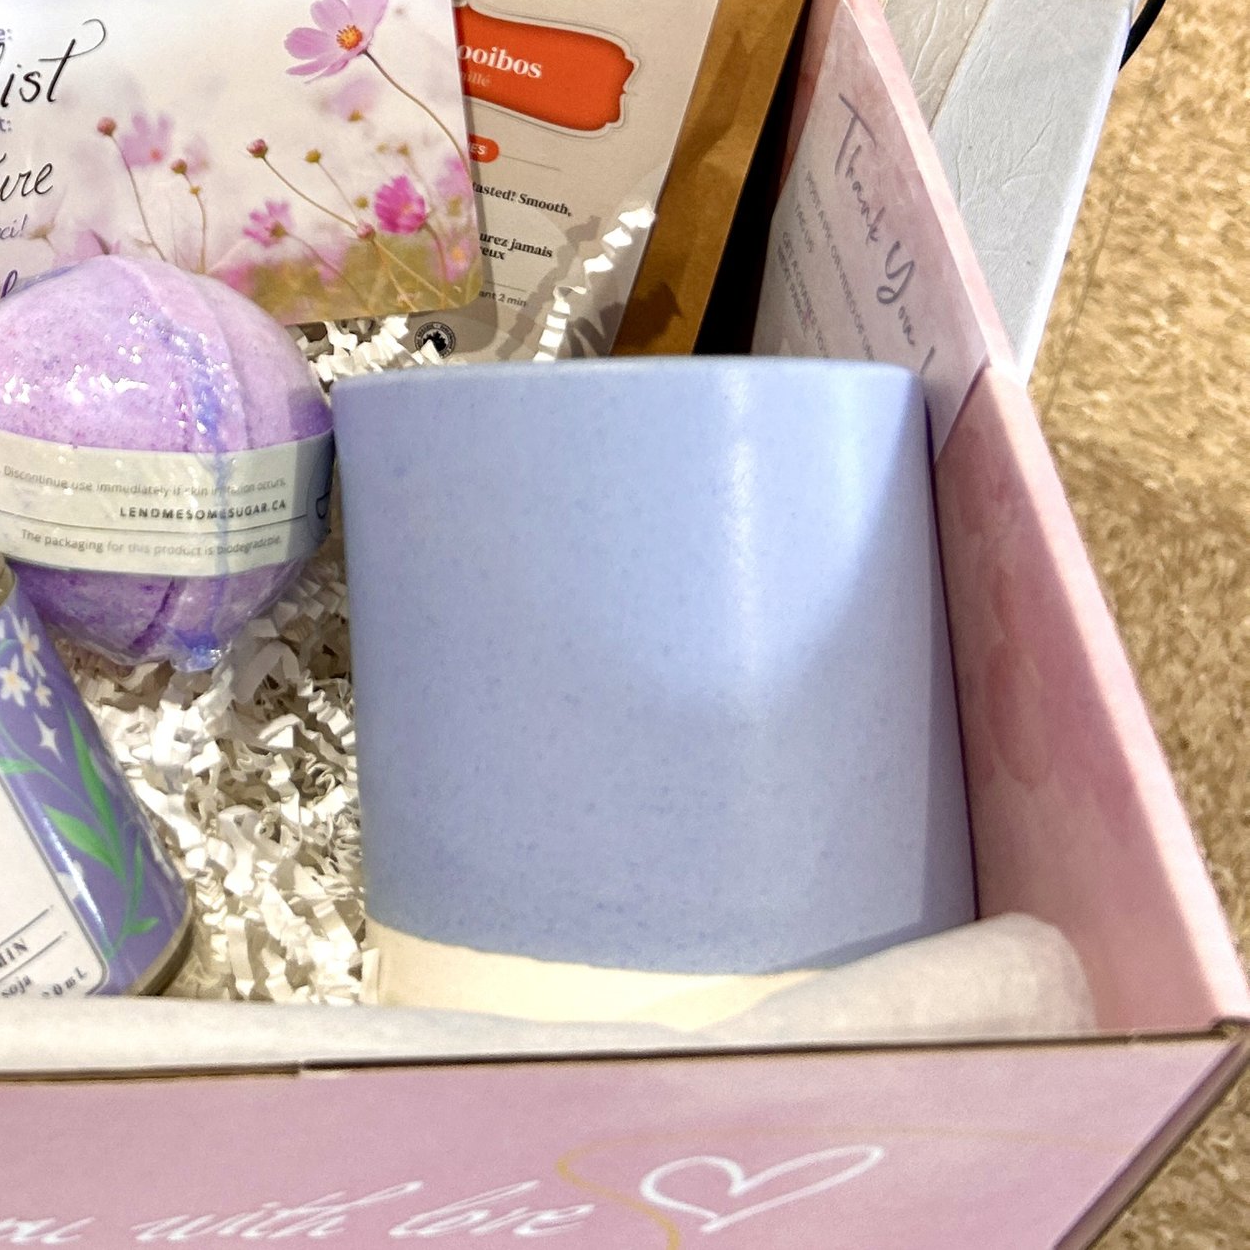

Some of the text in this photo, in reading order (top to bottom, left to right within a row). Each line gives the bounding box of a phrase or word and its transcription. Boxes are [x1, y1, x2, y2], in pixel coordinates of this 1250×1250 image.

[518, 193, 573, 217] Smooth,
[834, 92, 886, 245] Thank
[876, 240, 916, 346] You
[507, 237, 553, 258] jamais
[498, 293, 506, 302] 2
[506, 297, 527, 308] min
[3, 464, 68, 489] Discontinue
[44, 534, 103, 554] packaging
[106, 540, 125, 553] for
[130, 1180, 425, 1244] with
[388, 1179, 596, 1238] love
